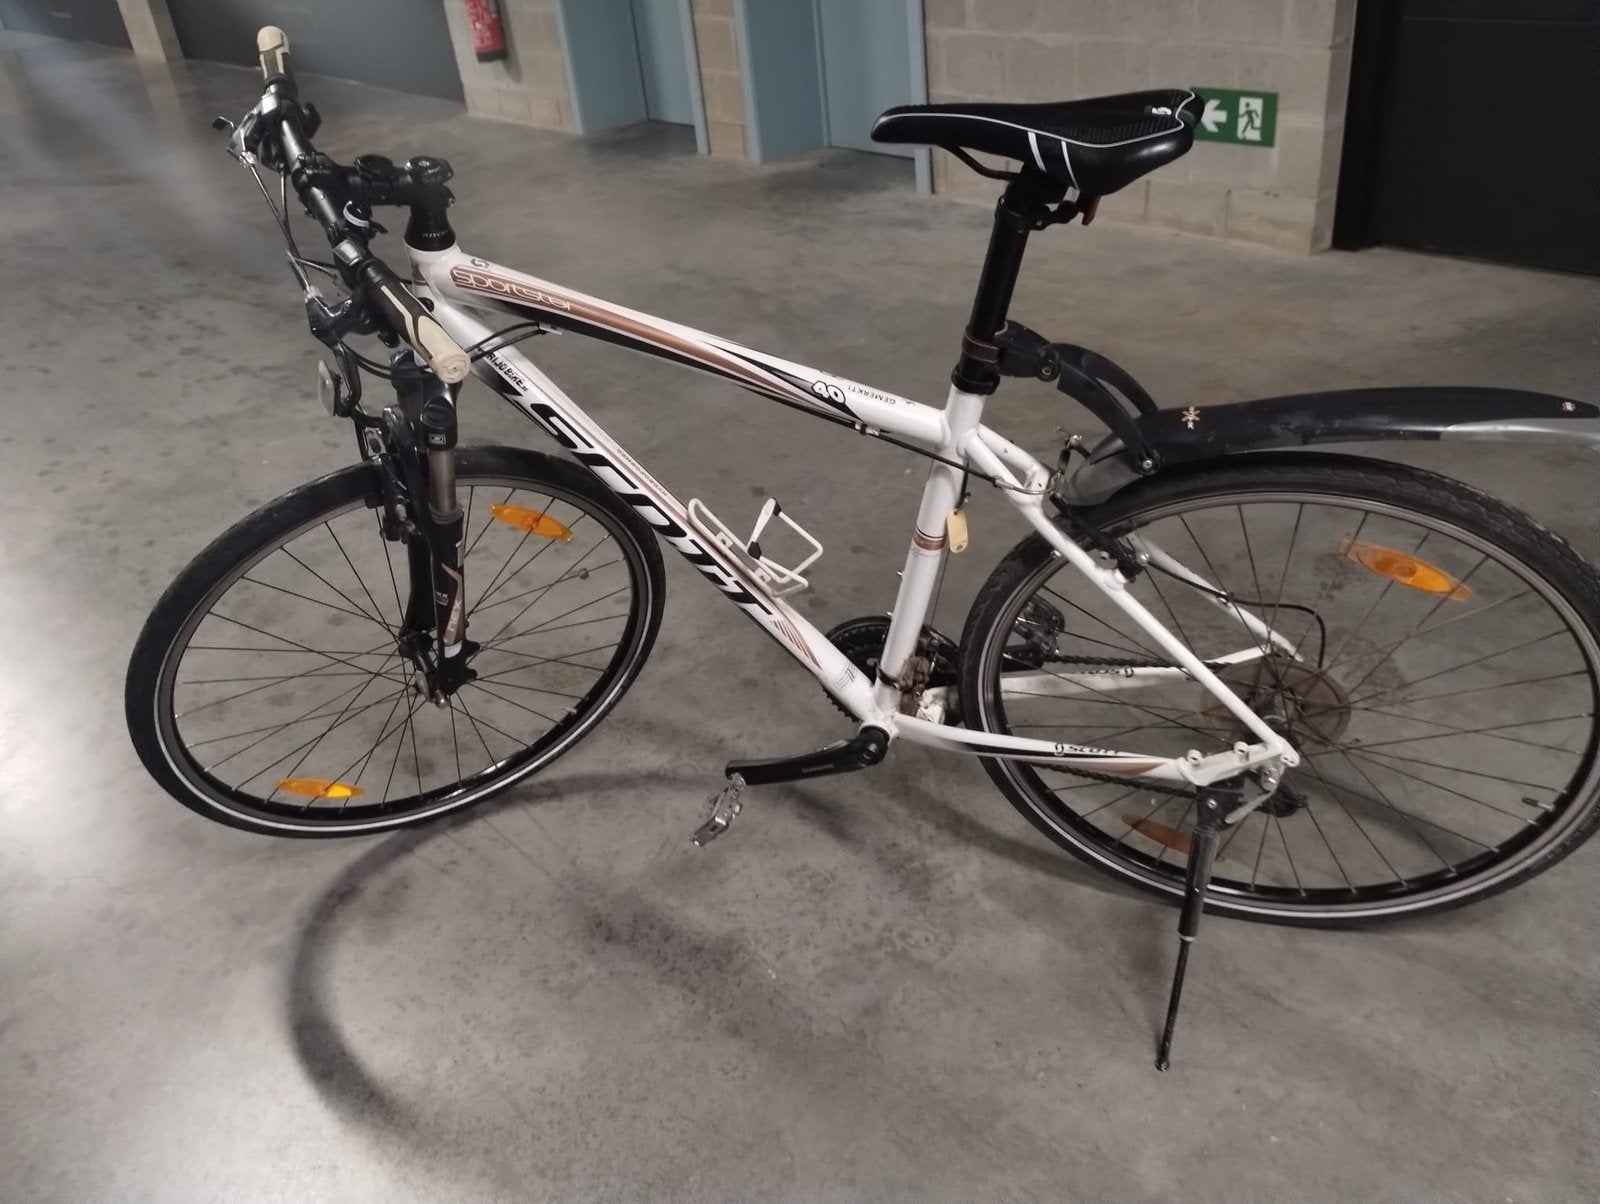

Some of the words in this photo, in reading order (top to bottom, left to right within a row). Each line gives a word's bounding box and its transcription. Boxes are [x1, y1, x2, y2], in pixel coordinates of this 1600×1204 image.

[811, 380, 846, 405] 40
[847, 385, 896, 405] GEMERKT!
[530, 403, 773, 615] SCOTT
